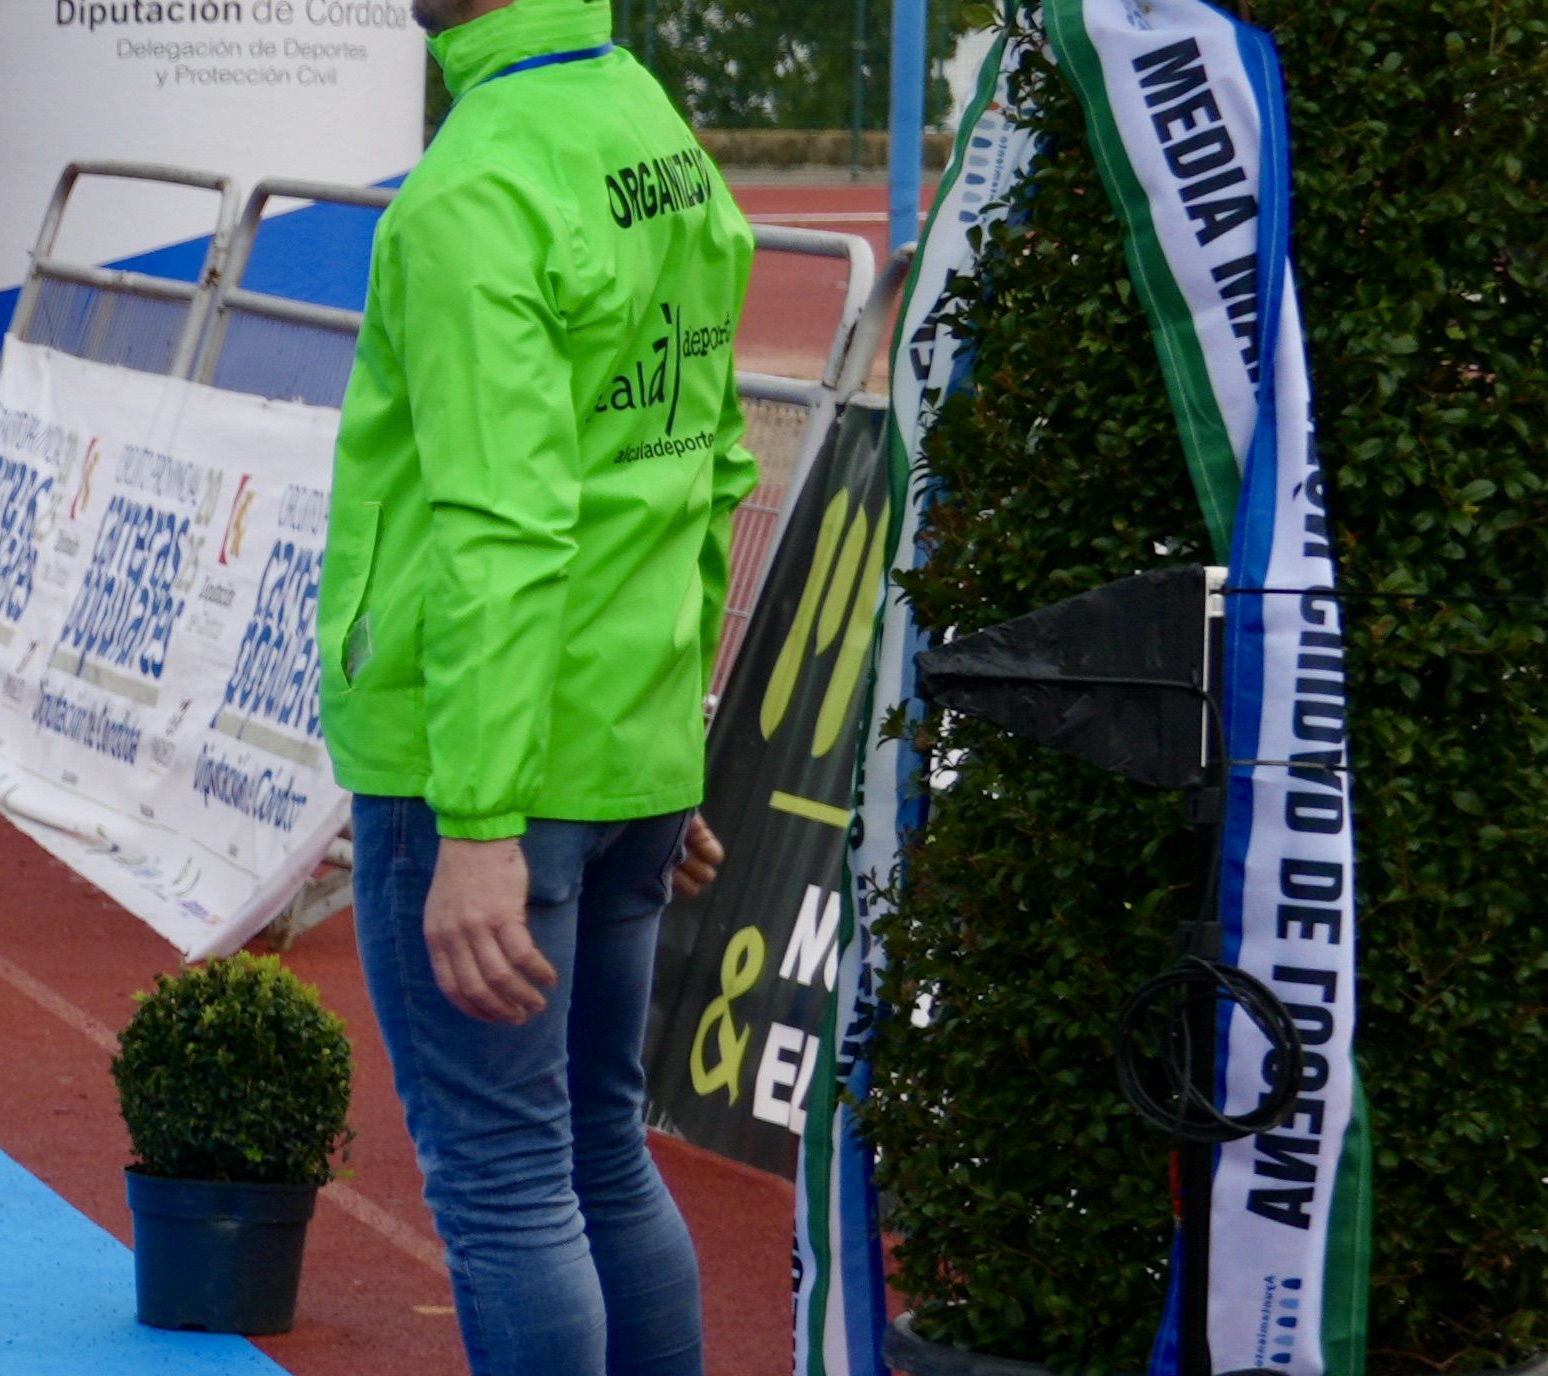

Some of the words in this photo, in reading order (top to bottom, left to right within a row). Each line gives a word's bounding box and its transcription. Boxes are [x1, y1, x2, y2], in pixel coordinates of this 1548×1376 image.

[116, 36, 242, 62] Delegación
[249, 38, 276, 58] de
[283, 38, 367, 62] Deportes
[156, 70, 166, 89] y
[175, 65, 291, 87] Protección
[296, 65, 338, 87] Civil
[1131, 37, 1259, 248] MEDIA
[689, 925, 767, 1106] &
